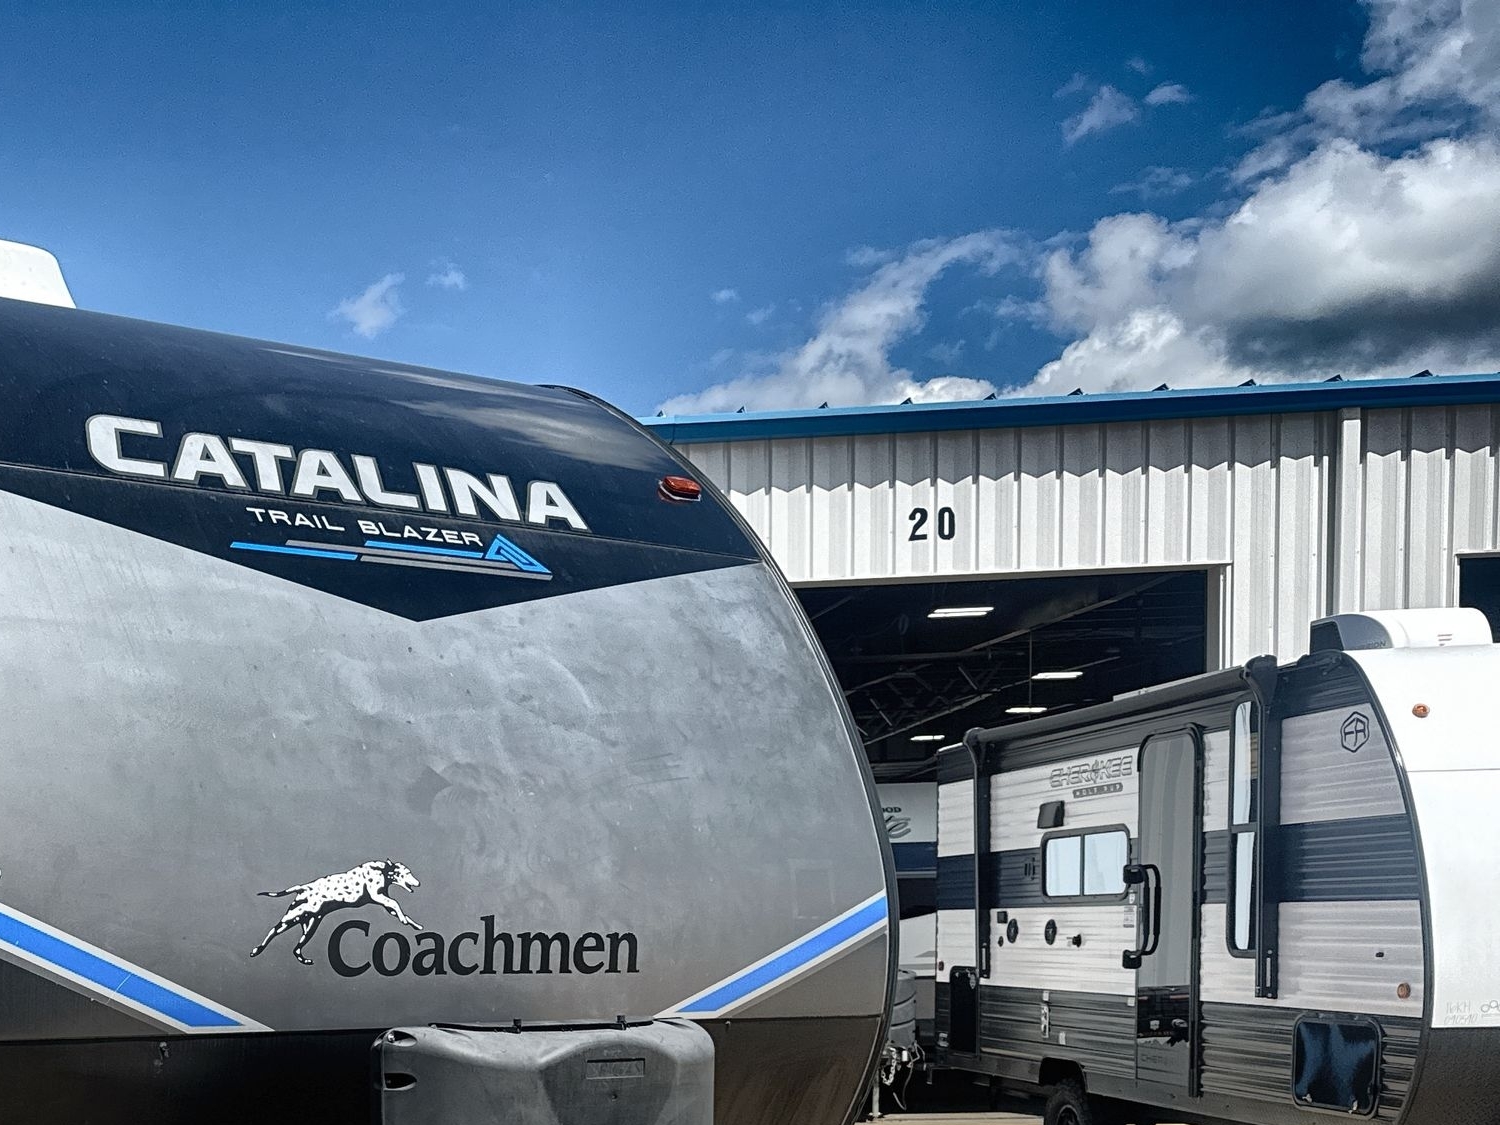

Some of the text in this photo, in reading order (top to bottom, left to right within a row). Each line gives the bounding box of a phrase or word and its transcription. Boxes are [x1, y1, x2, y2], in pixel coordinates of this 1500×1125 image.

[85, 413, 588, 531] CATALINA
[245, 506, 483, 547] TRAIL BLAZER
[908, 507, 956, 541] 20
[327, 914, 640, 978] Coachmen
